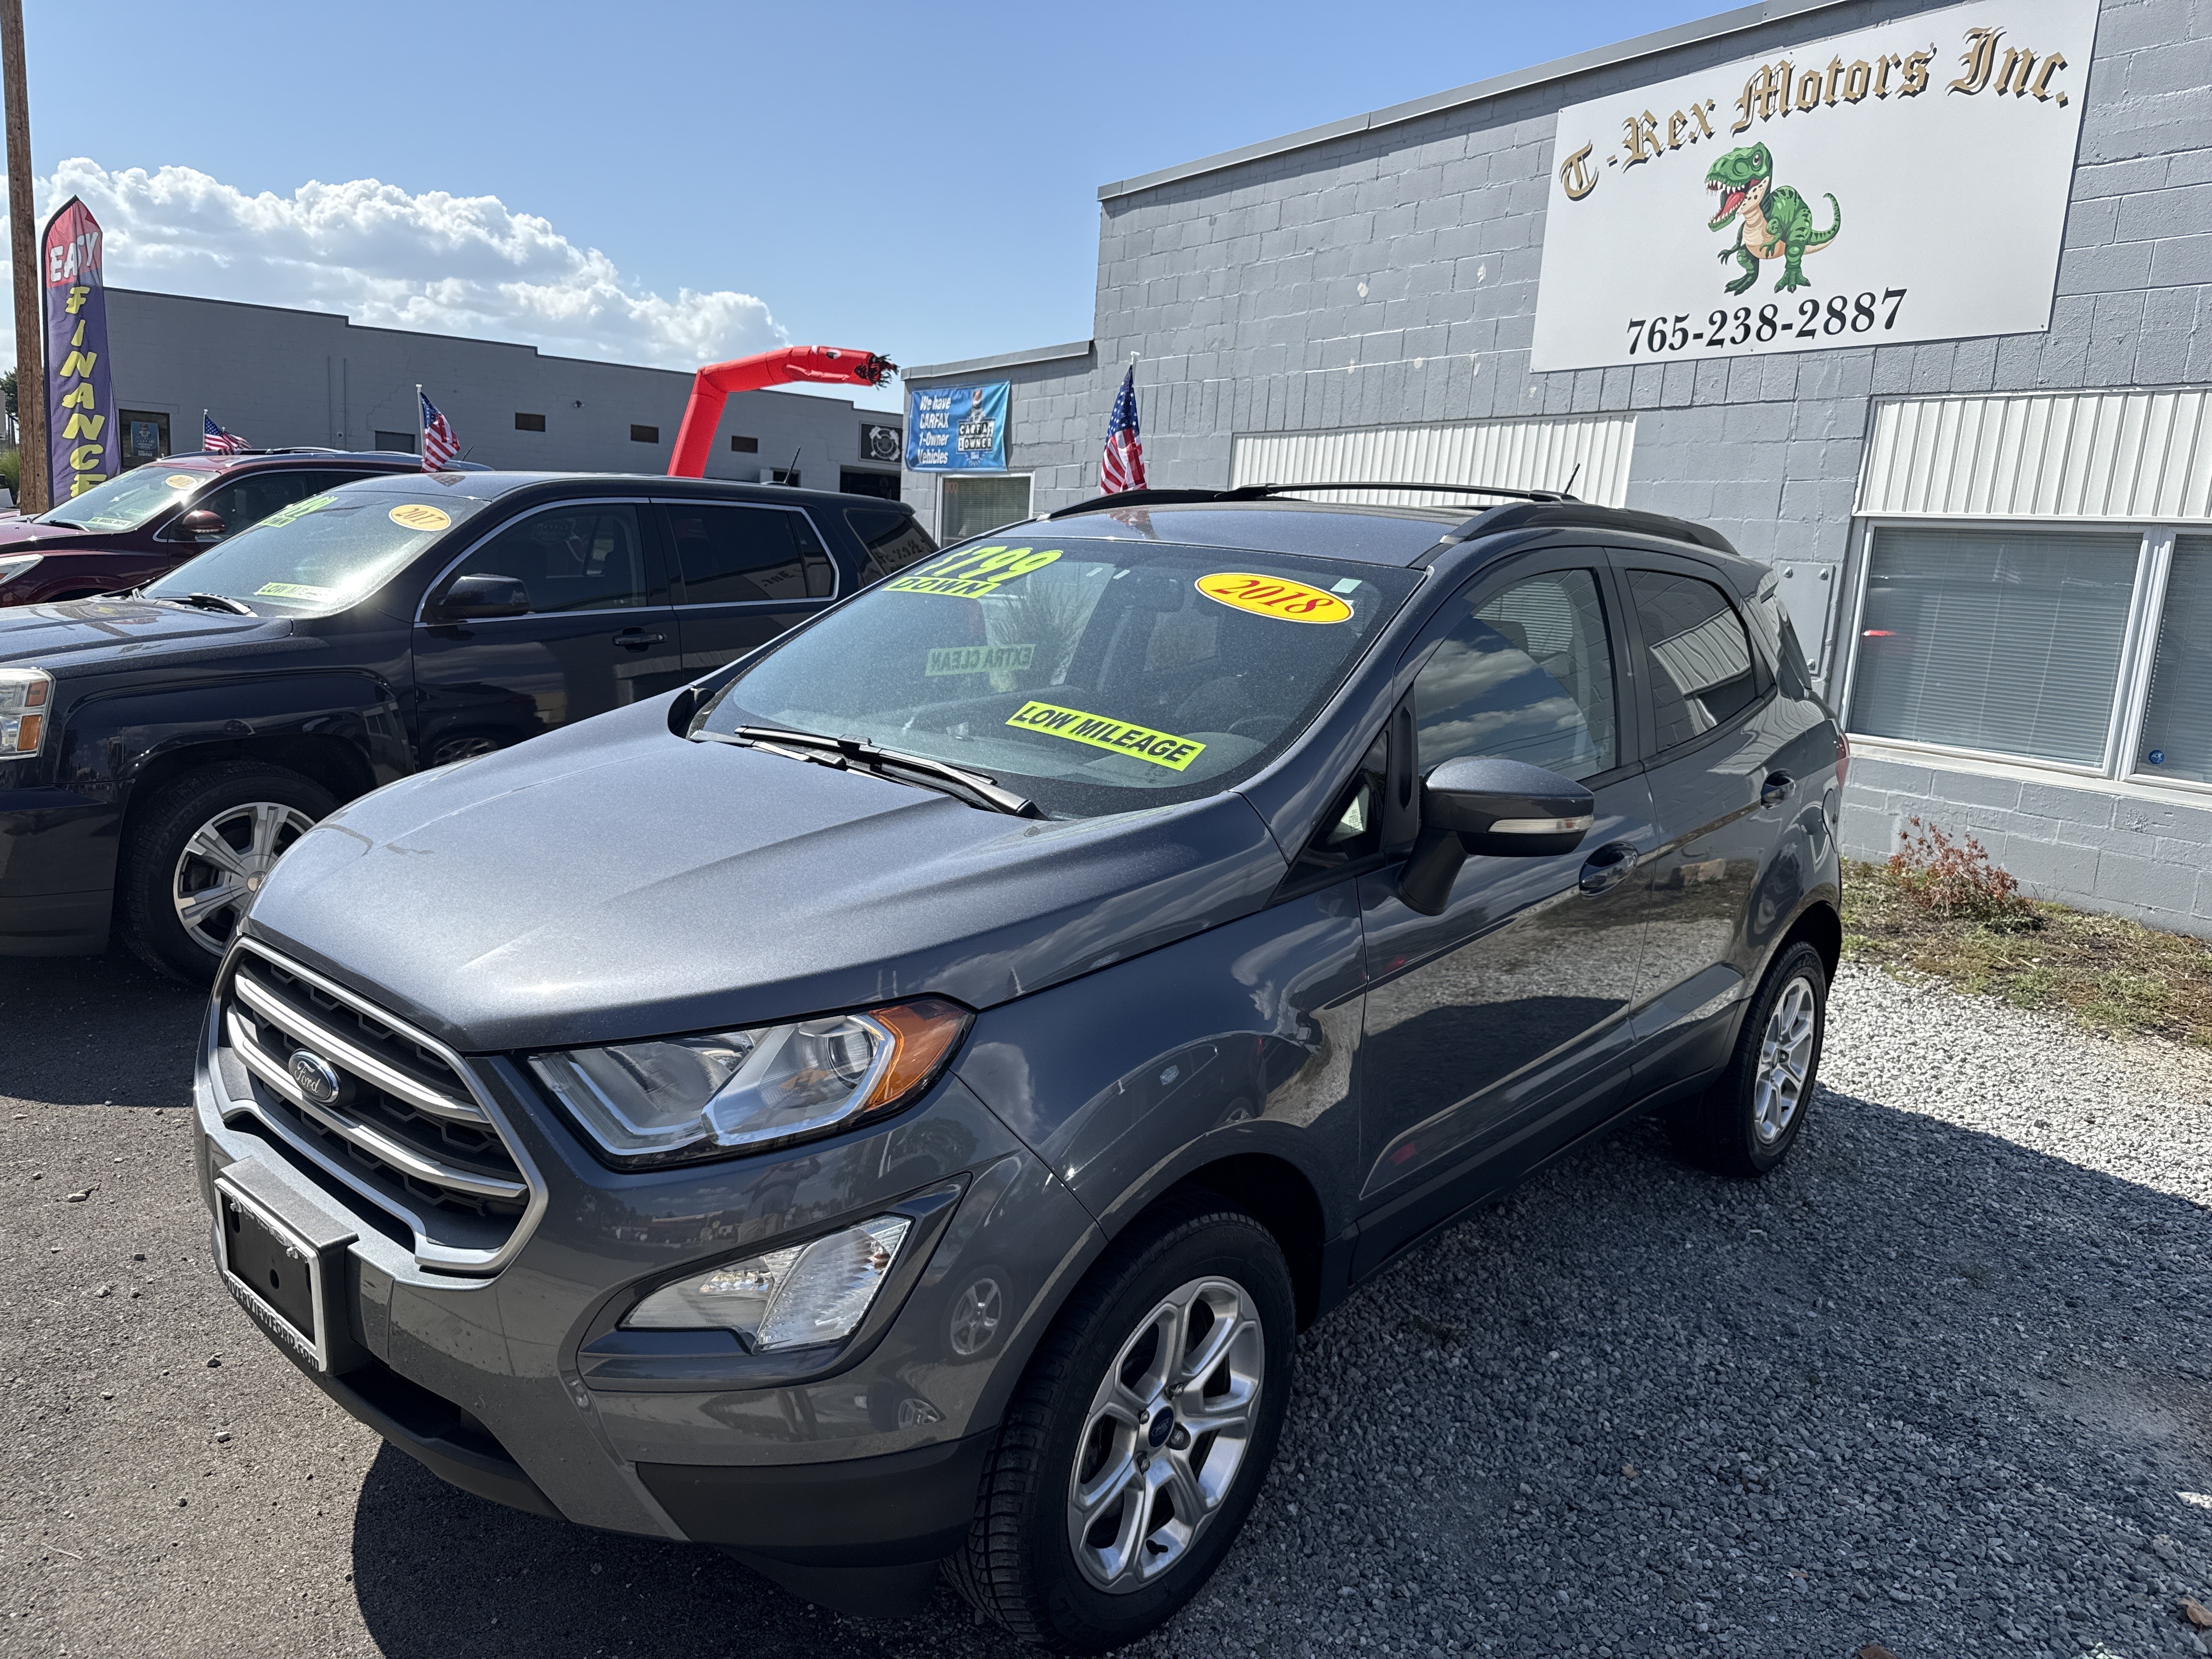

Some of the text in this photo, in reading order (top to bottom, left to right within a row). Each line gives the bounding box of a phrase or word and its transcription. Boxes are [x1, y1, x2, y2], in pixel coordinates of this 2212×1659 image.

[1730, 42, 1938, 138] Motors
[1945, 26, 2069, 109] Inc.
[50, 231, 99, 282] EASY
[1626, 287, 1908, 355] 765-238-2887
[919, 394, 951, 411] We have
[919, 413, 950, 430] CARFAX
[960, 422, 993, 435] CARFAX
[919, 431, 950, 447] 1-Owner
[917, 449, 949, 465] Vehicles
[394, 507, 446, 526] 2017
[892, 578, 992, 595] DOWN
[1210, 579, 1334, 613] 2018
[1013, 706, 1198, 763] LOW MILEAGE
[294, 1060, 321, 1093] Ford
